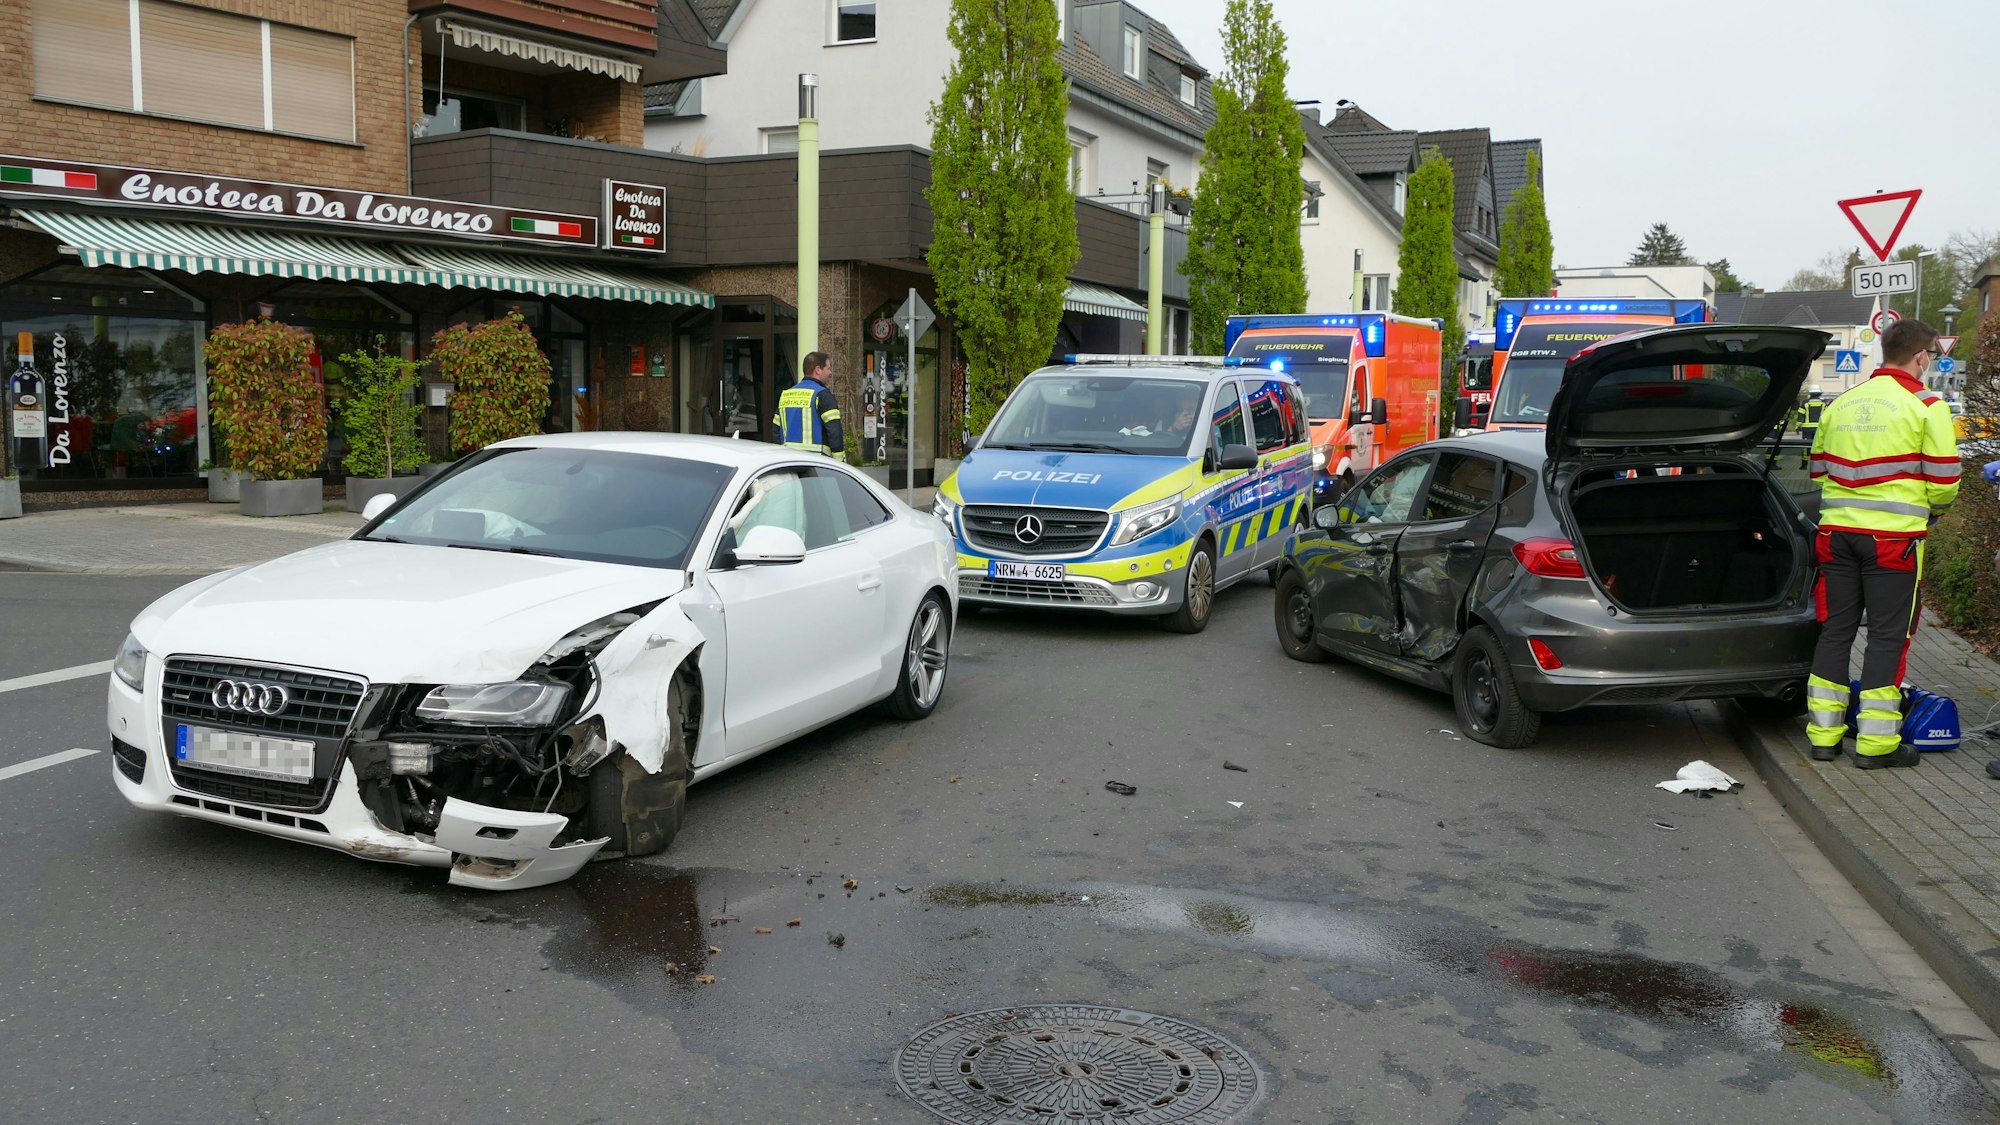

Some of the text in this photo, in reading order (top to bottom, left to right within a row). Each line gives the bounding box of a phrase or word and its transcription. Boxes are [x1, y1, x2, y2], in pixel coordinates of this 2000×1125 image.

[120, 173, 493, 232] Enoteca Da Lorenzo
[615, 188, 661, 206] Enoteca
[629, 204, 646, 219] Da
[615, 215, 661, 234] Lorenzo
[1860, 272, 1907, 289] 50 m
[1317, 356, 1349, 364] Siegburg
[48, 332, 71, 467] Da Lorenzo
[877, 356, 886, 461] Da Lorenzo
[993, 469, 1102, 485] POLIZEI
[1229, 486, 1254, 511] POLIZEI
[995, 563, 1016, 577] NRW
[1928, 729, 1952, 738] ZOLL
